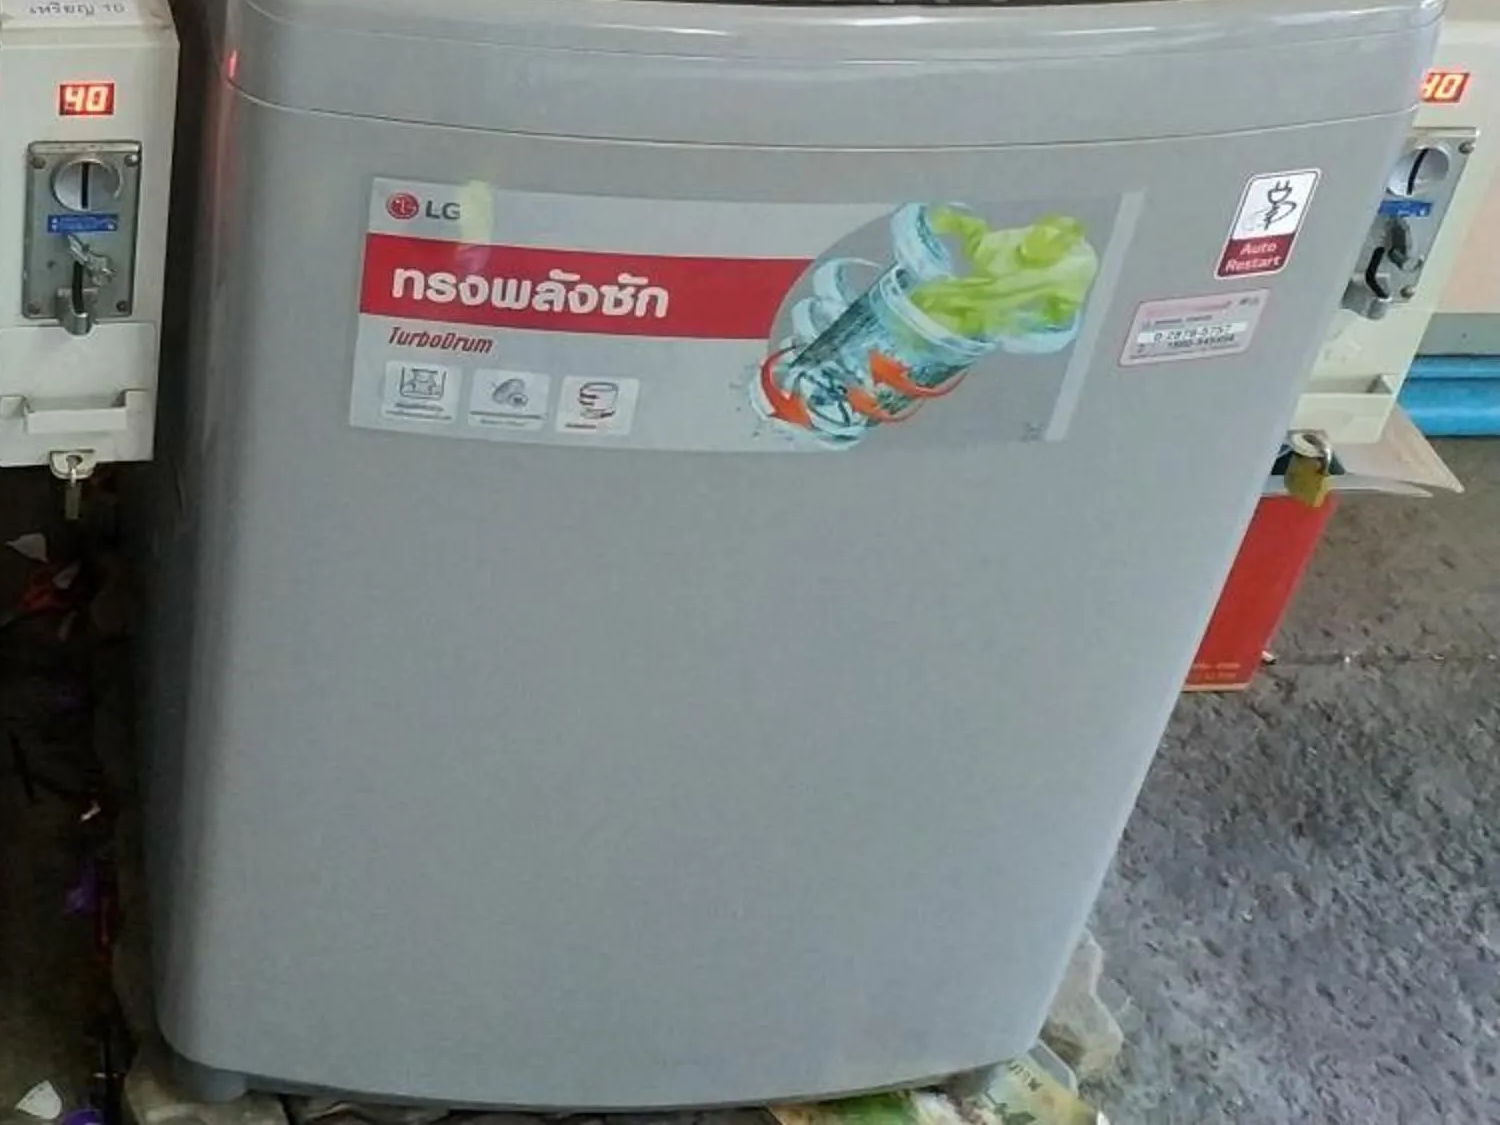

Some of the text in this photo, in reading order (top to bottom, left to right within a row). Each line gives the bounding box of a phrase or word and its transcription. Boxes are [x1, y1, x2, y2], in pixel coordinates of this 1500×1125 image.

[64, 86, 108, 112] 40
[425, 200, 461, 220] LG
[1239, 242, 1278, 256] Auto
[1225, 256, 1281, 272] Restart
[391, 269, 669, 318] ทรงพลังซัก
[388, 326, 493, 354] TurboDrum
